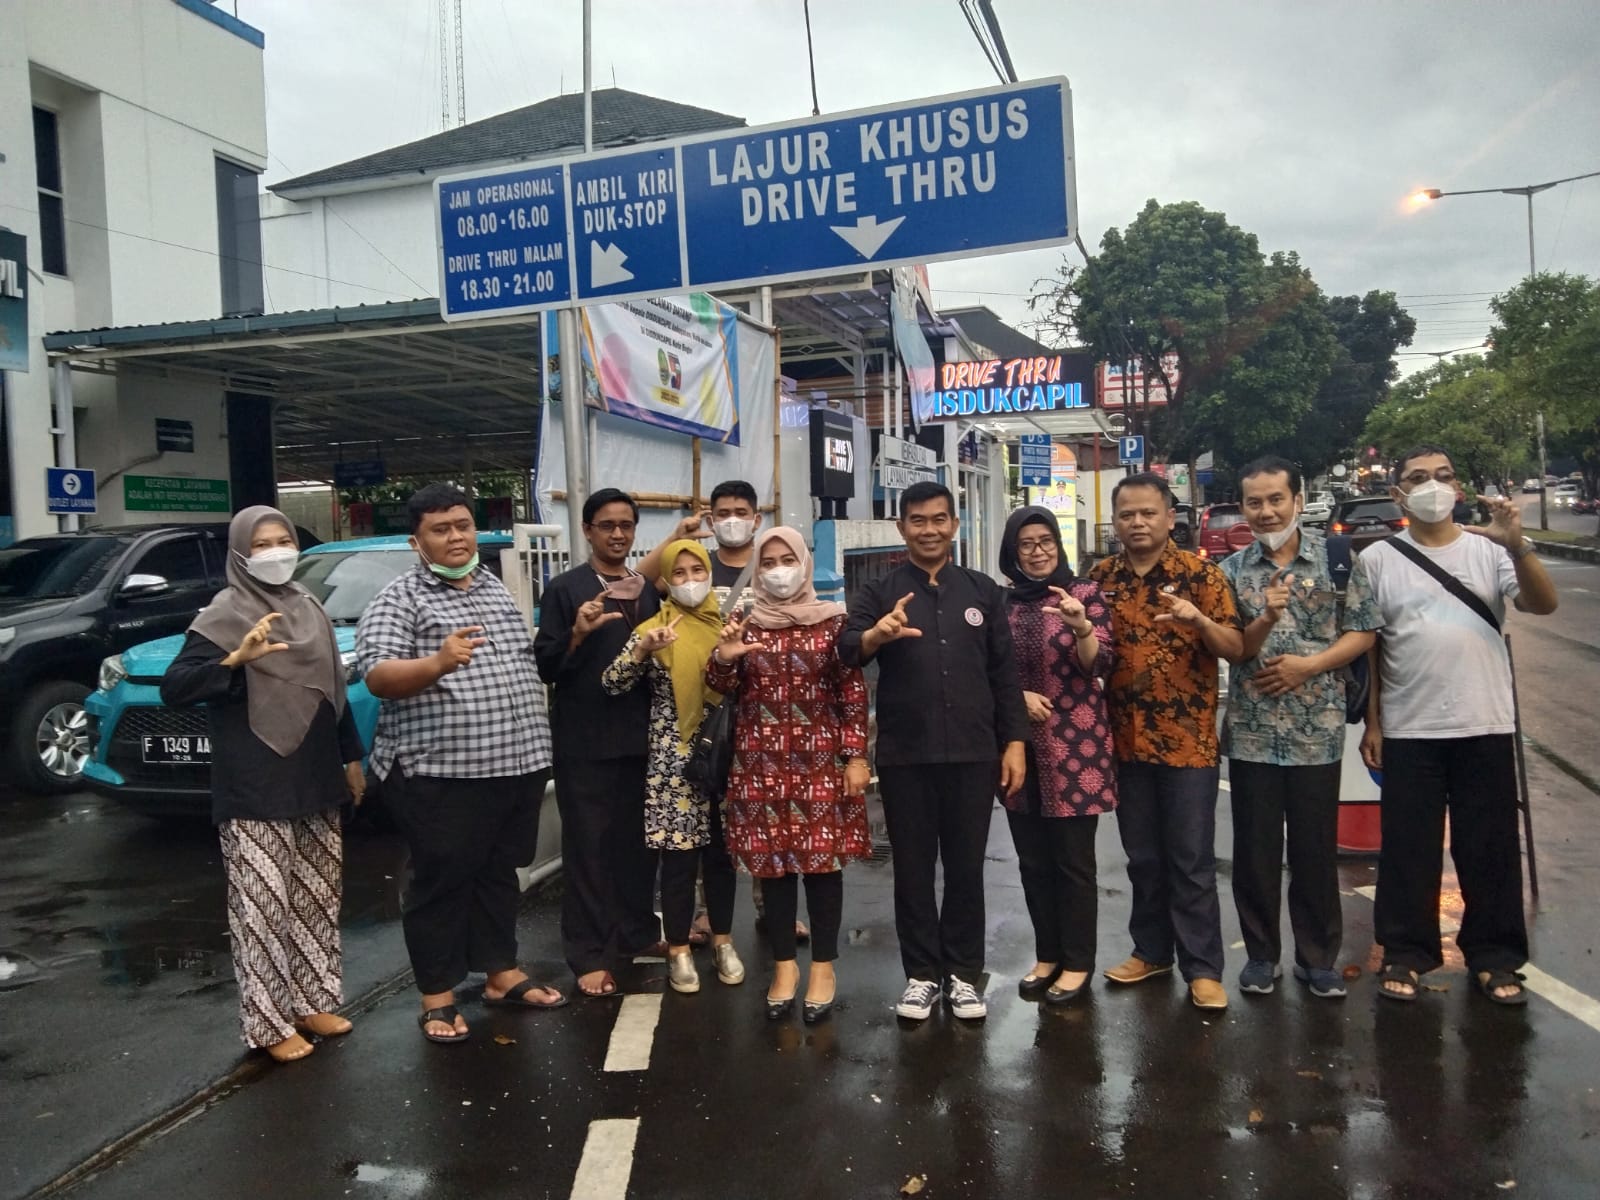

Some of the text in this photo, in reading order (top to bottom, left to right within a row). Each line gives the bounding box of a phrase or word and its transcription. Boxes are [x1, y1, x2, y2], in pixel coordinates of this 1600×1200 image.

[708, 98, 1029, 187] LAJUR KHUSUS
[449, 178, 555, 210] JAM OPERASIONAL
[576, 168, 674, 206] AMBIL KIRI
[741, 150, 996, 227] DRIVE THRU
[583, 199, 667, 234] DUK-STOP
[449, 242, 563, 273] DRIVE THRU MALAM
[941, 355, 1062, 390] DRIVE THRU
[1125, 438, 1138, 458] P
[144, 737, 213, 754] F 1349 AA
